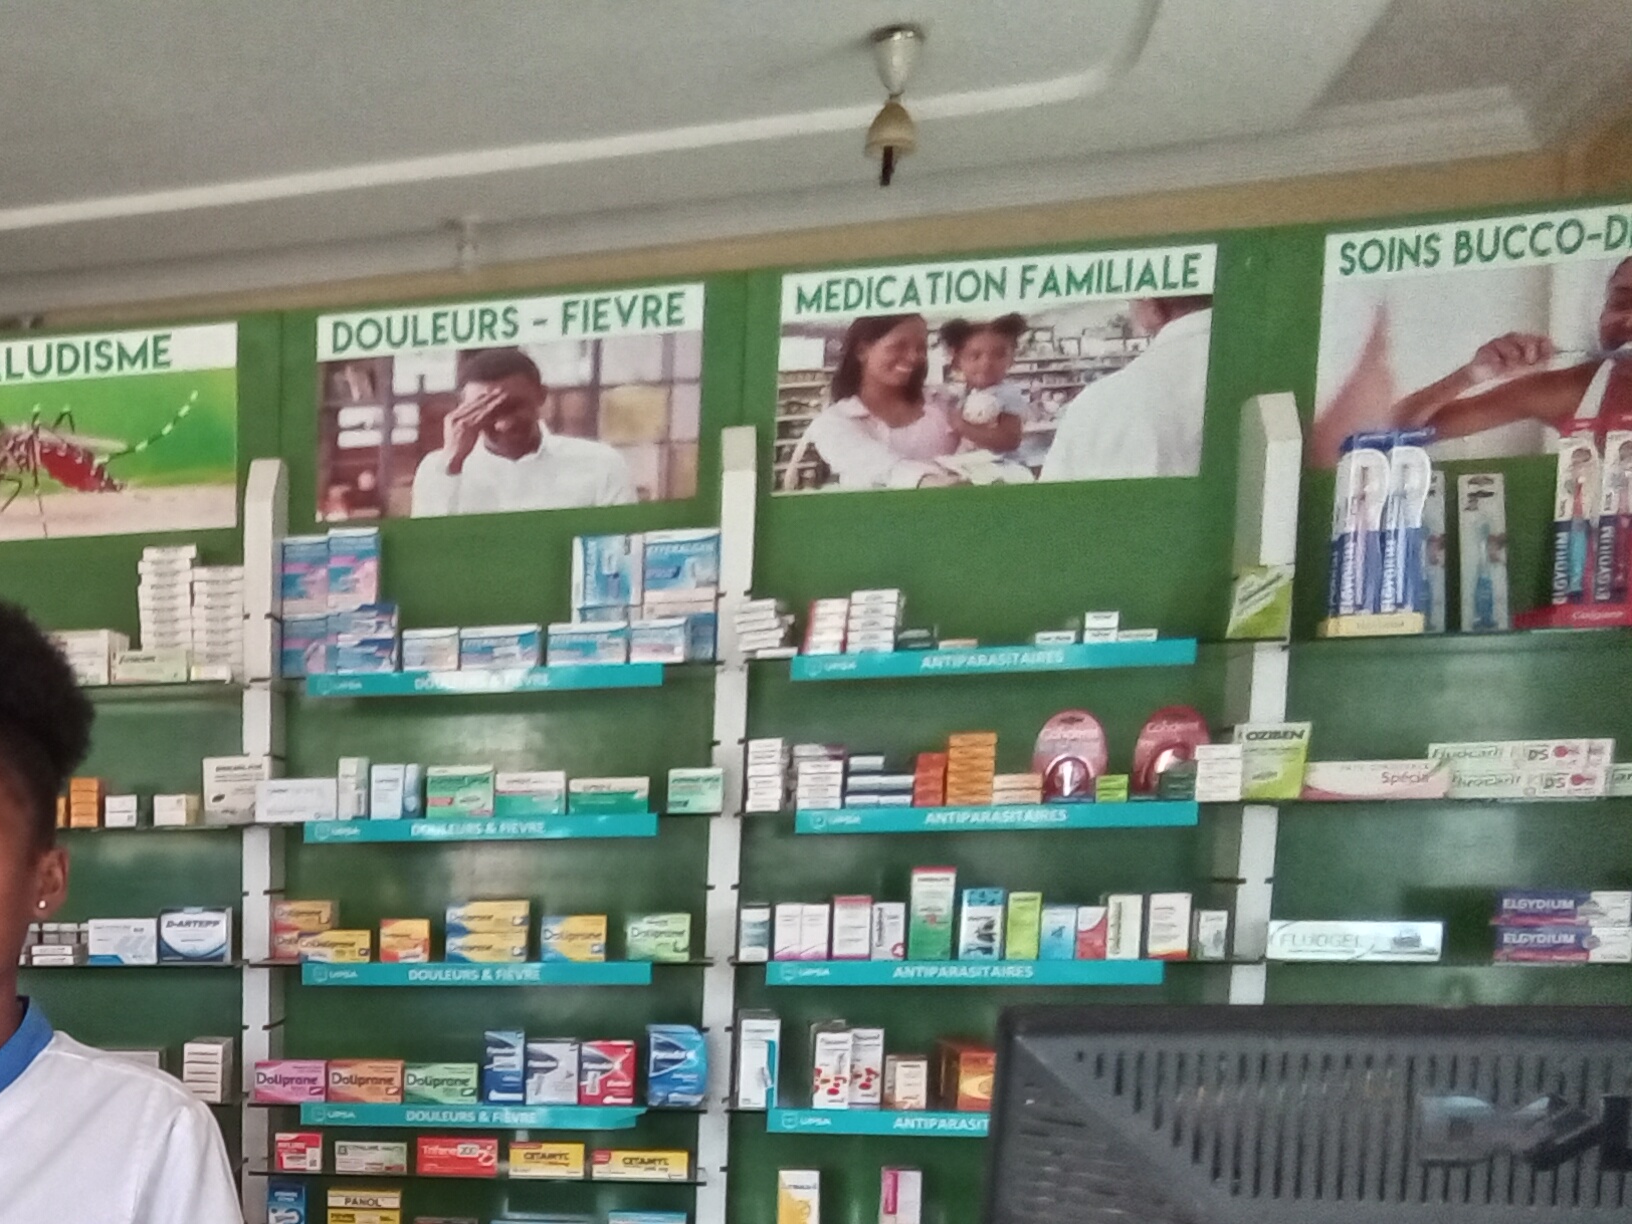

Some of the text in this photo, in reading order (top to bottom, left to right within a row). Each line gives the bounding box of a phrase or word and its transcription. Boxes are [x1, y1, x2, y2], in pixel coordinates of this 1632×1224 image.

[1340, 212, 1632, 275] SOINS BUCCO-D
[796, 253, 1202, 316] MEDICATION FAMILIALE
[331, 304, 520, 352] DOULEURS
[561, 292, 686, 336] FIEVRE
[921, 649, 1065, 669] ANTIPARASITAIRES
[925, 806, 1069, 825] ANTIPARASITAIRES
[1503, 897, 1574, 910] ELGYDIUM
[1504, 932, 1575, 945] ELGYDIUM
[408, 968, 478, 981] DOULEURS
[893, 964, 1034, 981] ANTIPARASITAIRES
[256, 1072, 318, 1087] Doliprane
[331, 1072, 394, 1087] Doliprane
[407, 1073, 471, 1088] Doliprane
[406, 1110, 475, 1123] DOULEURS
[479, 1110, 489, 1123] &
[893, 1116, 990, 1131] ANTIPARASIT
